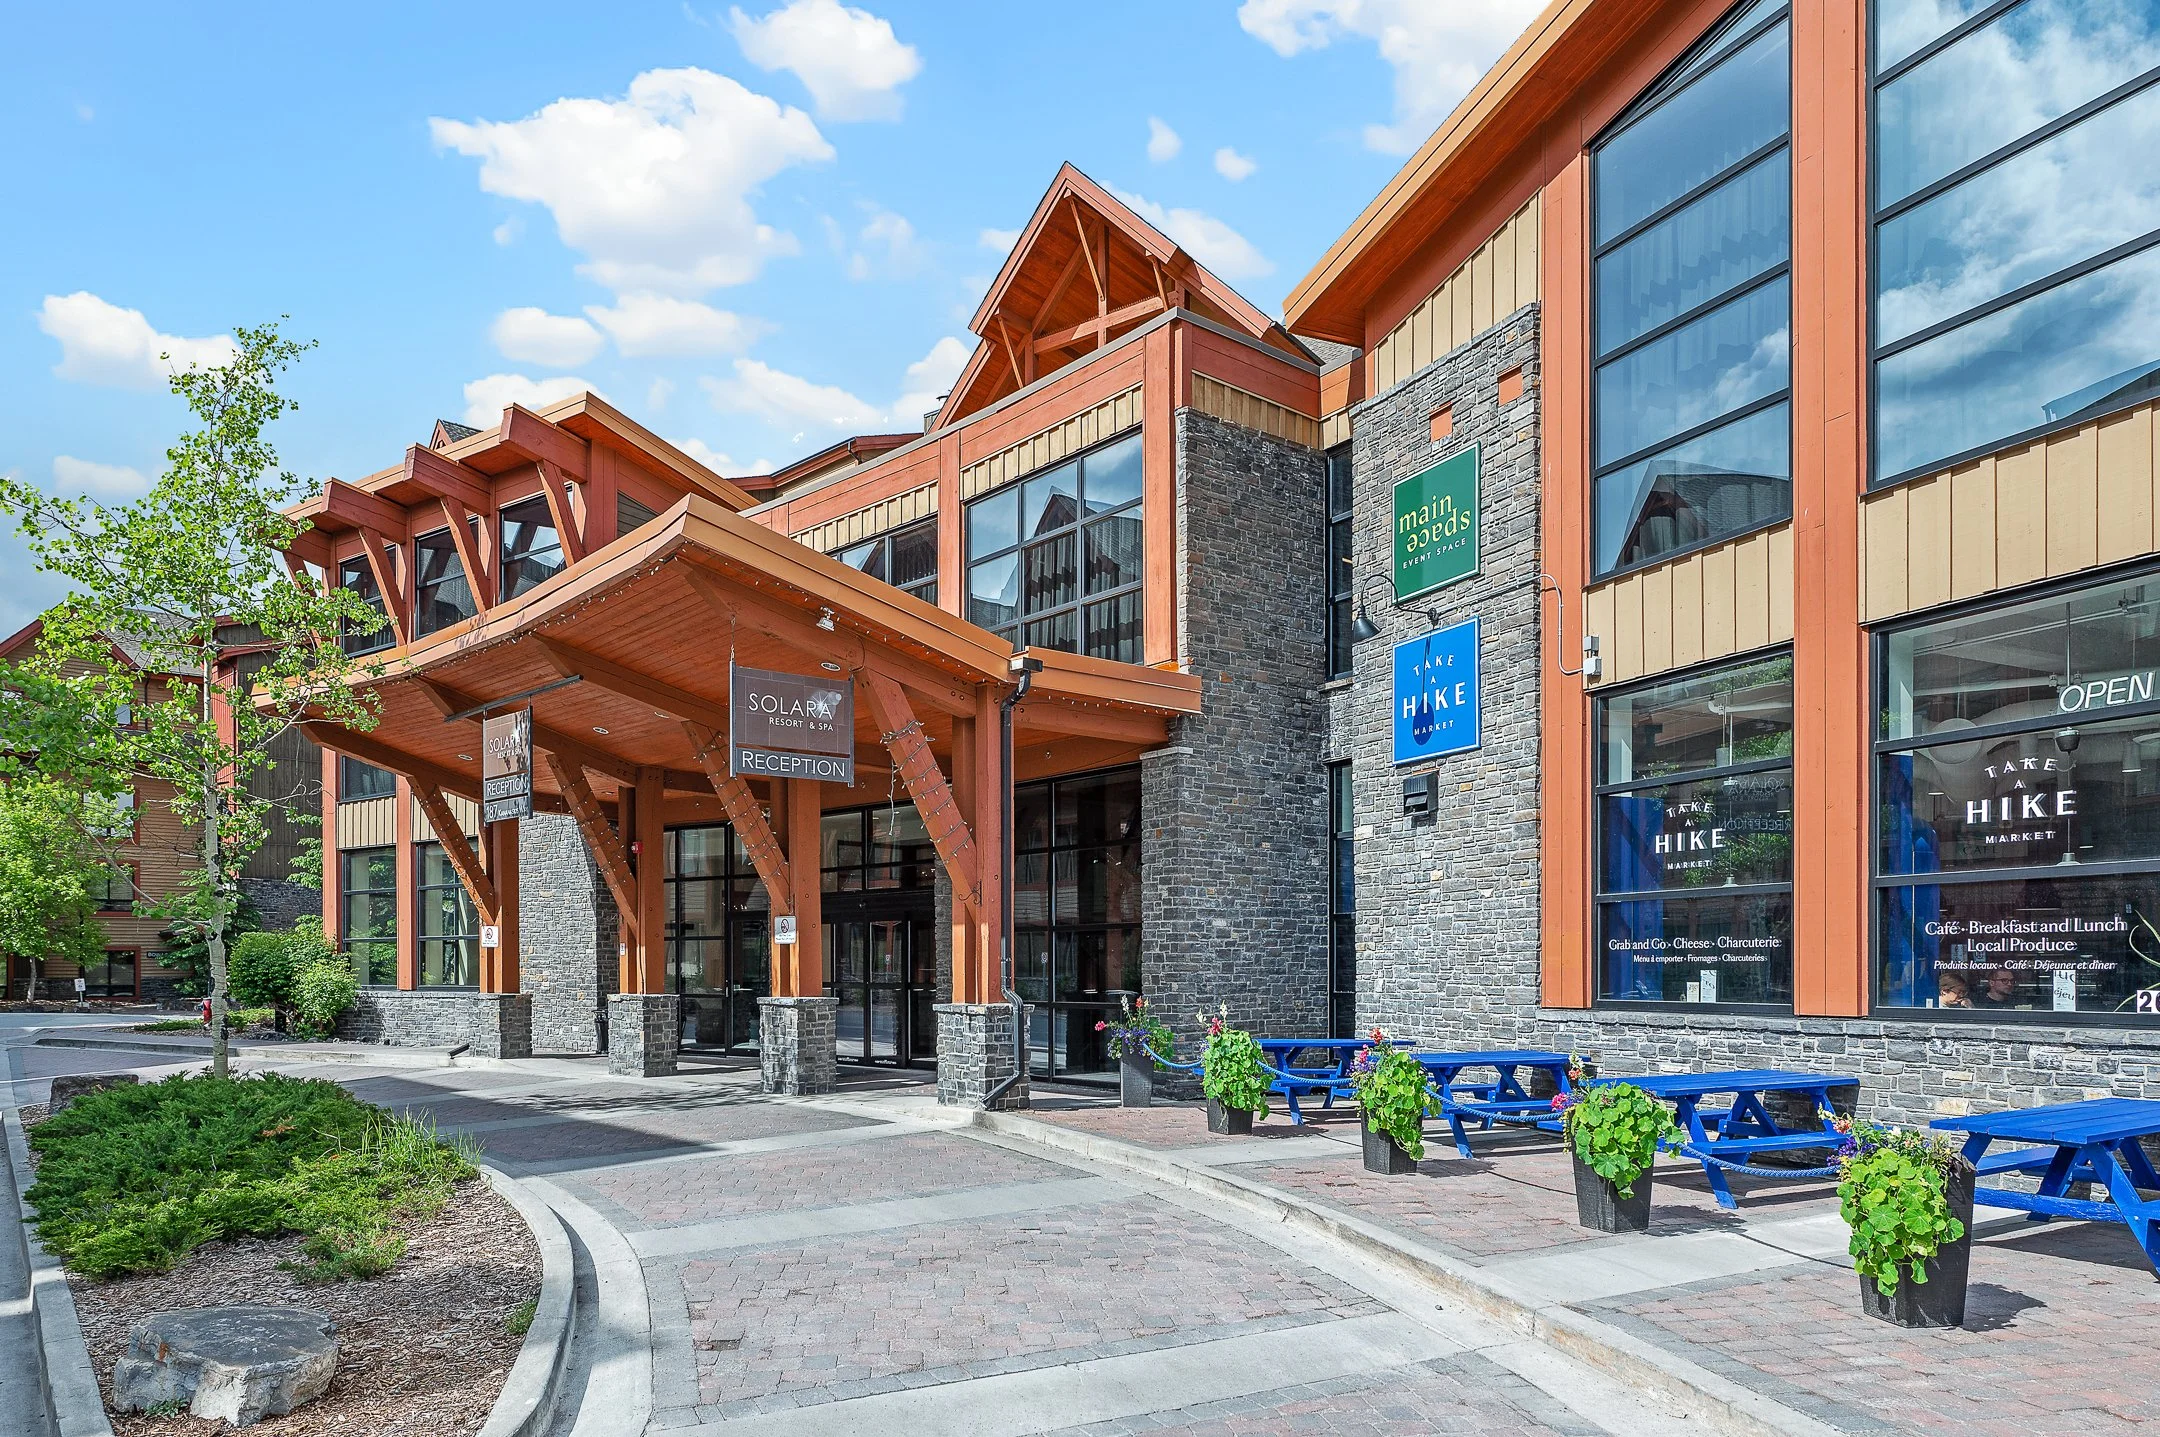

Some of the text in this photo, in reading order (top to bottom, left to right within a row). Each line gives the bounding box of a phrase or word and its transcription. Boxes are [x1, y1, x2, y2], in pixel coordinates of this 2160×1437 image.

[1399, 494, 1452, 534] main
[1406, 508, 1472, 552] space
[1402, 537, 1467, 569] EVENT SPACE
[1412, 654, 1454, 677] TAKE
[1430, 675, 1437, 684] A
[1402, 681, 1466, 719] HIKE
[2060, 672, 2153, 712] OPEN
[748, 692, 833, 720] SOLARA
[769, 717, 834, 731] RESORT & SPA
[1413, 720, 1454, 736] MARKET
[489, 733, 521, 754] SOLARA
[741, 751, 845, 777] RECEPTION
[1984, 757, 2058, 778] TAKE
[487, 773, 528, 797] RECEPTION
[2014, 779, 2023, 789] A
[486, 805, 498, 819] 187
[1666, 802, 1714, 817] TAKE
[1967, 790, 2074, 824] HIKE
[1655, 828, 1724, 854] HIKE
[1985, 830, 2054, 843] MARKET
[1667, 860, 1711, 870] MARKET
[1925, 916, 2125, 935] Café Breakfast and Lunch
[1609, 936, 1779, 950] Grab and Go Cheese Charcuterie
[1968, 937, 2075, 952] Local Produce
[1656, 956, 1683, 964] emporter
[1687, 954, 1718, 964] Fromages
[1722, 953, 1766, 962] Charcuteries
[1934, 960, 2116, 972] Produits locaux Café Déjeuner et dîner
